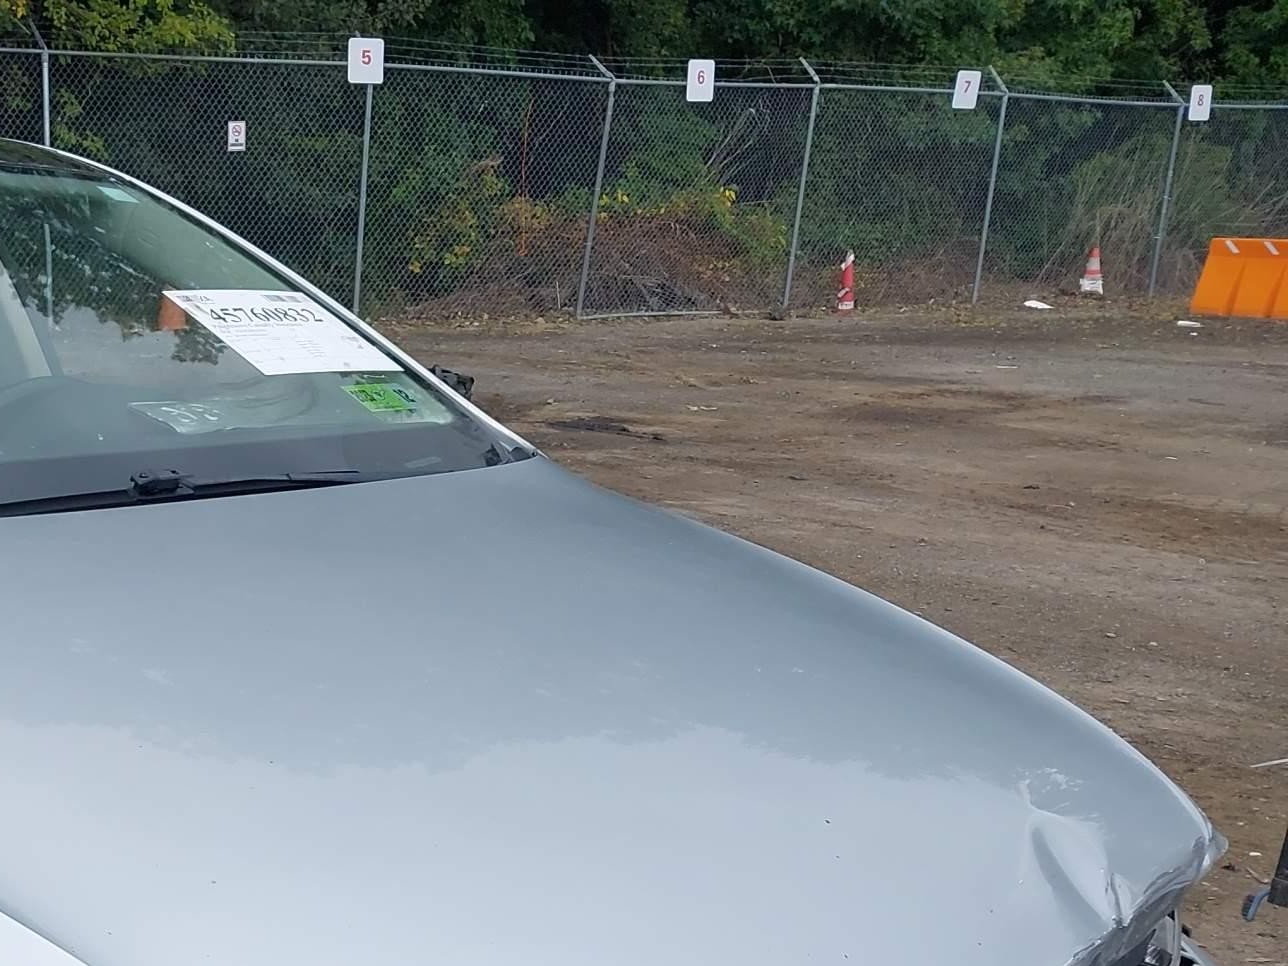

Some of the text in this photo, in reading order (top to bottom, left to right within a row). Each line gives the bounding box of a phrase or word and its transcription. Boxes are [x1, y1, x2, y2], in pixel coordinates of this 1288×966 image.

[361, 49, 372, 65] 5
[697, 70, 705, 84] 6
[964, 80, 971, 94] 7
[1197, 94, 1205, 106] 8
[210, 307, 324, 323] 45760832
